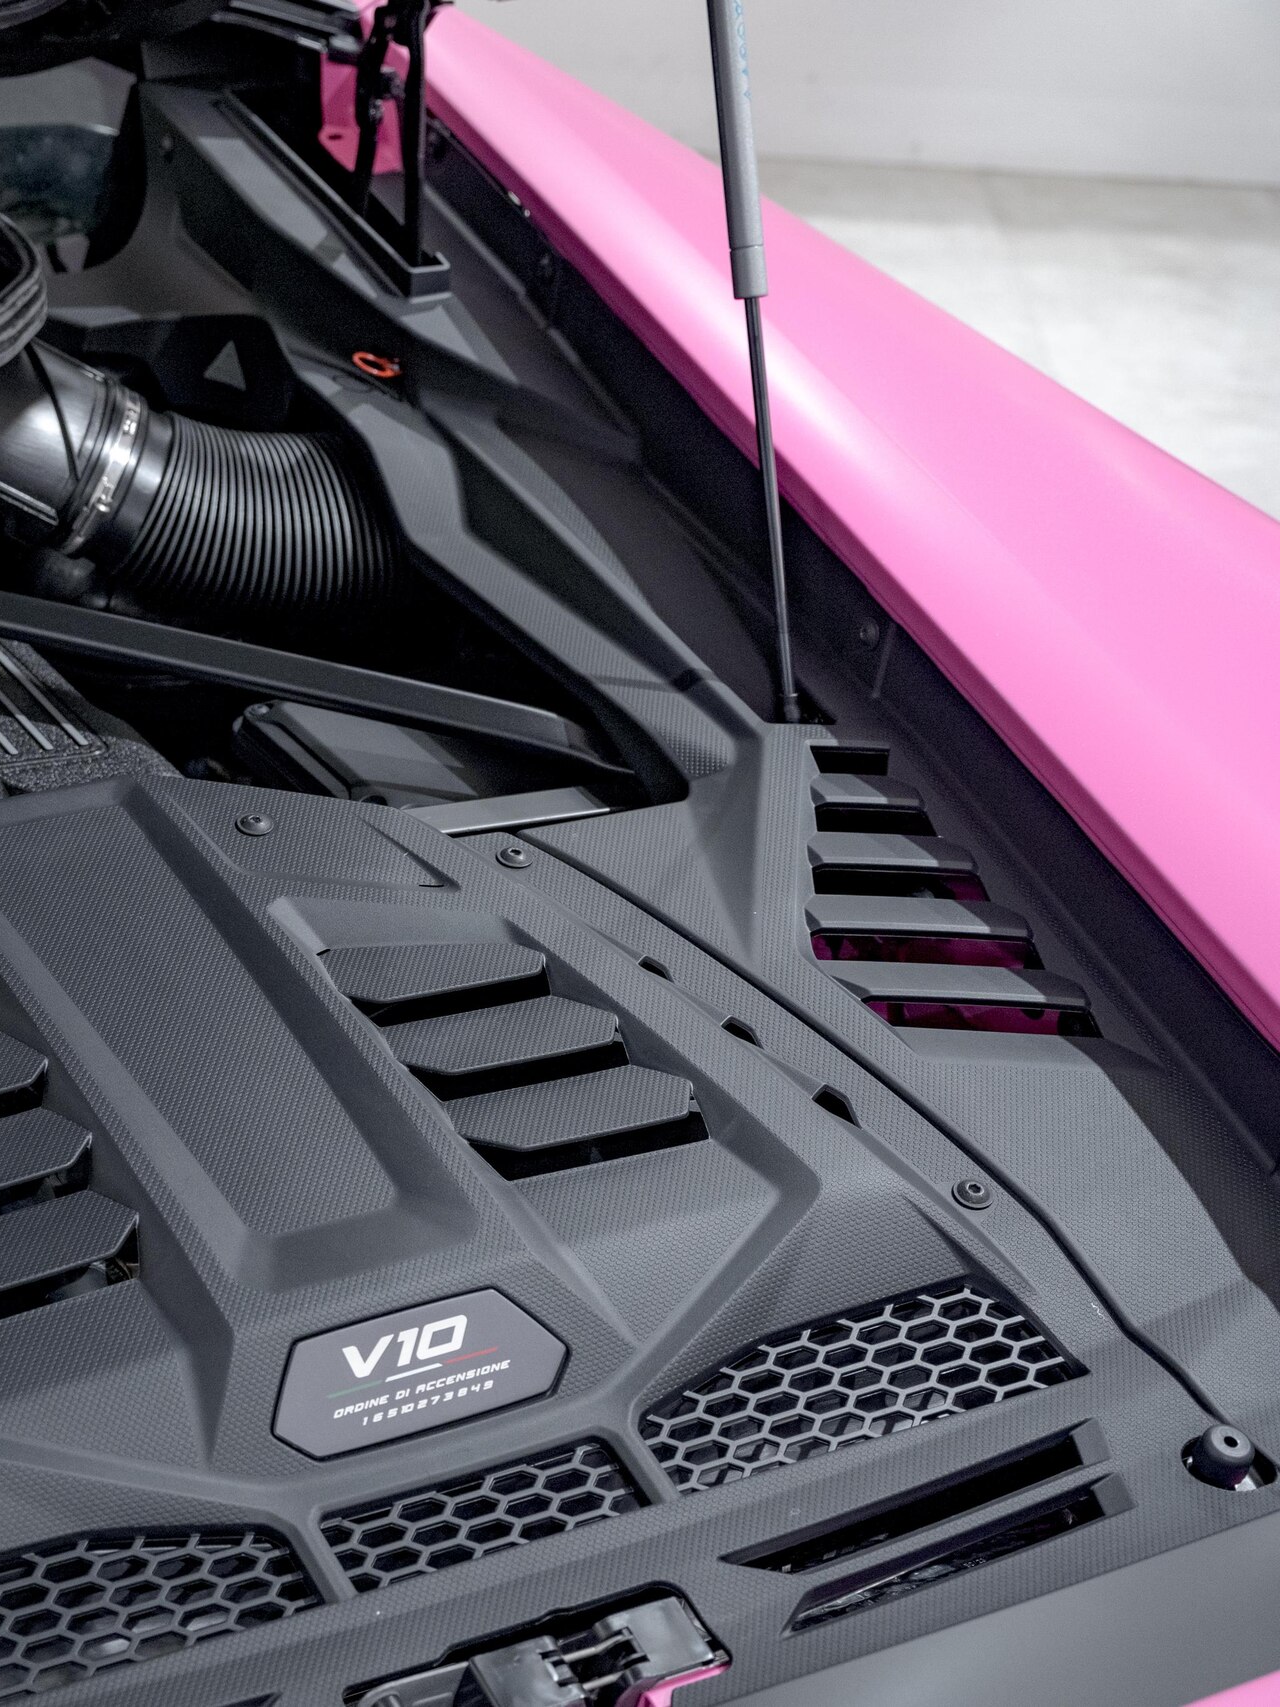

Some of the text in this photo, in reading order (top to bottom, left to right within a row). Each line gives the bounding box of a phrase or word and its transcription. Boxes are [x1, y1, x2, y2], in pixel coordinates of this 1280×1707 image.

[342, 1314, 468, 1379] V10
[333, 1359, 511, 1419] ORDINE DI ACCENSIONE
